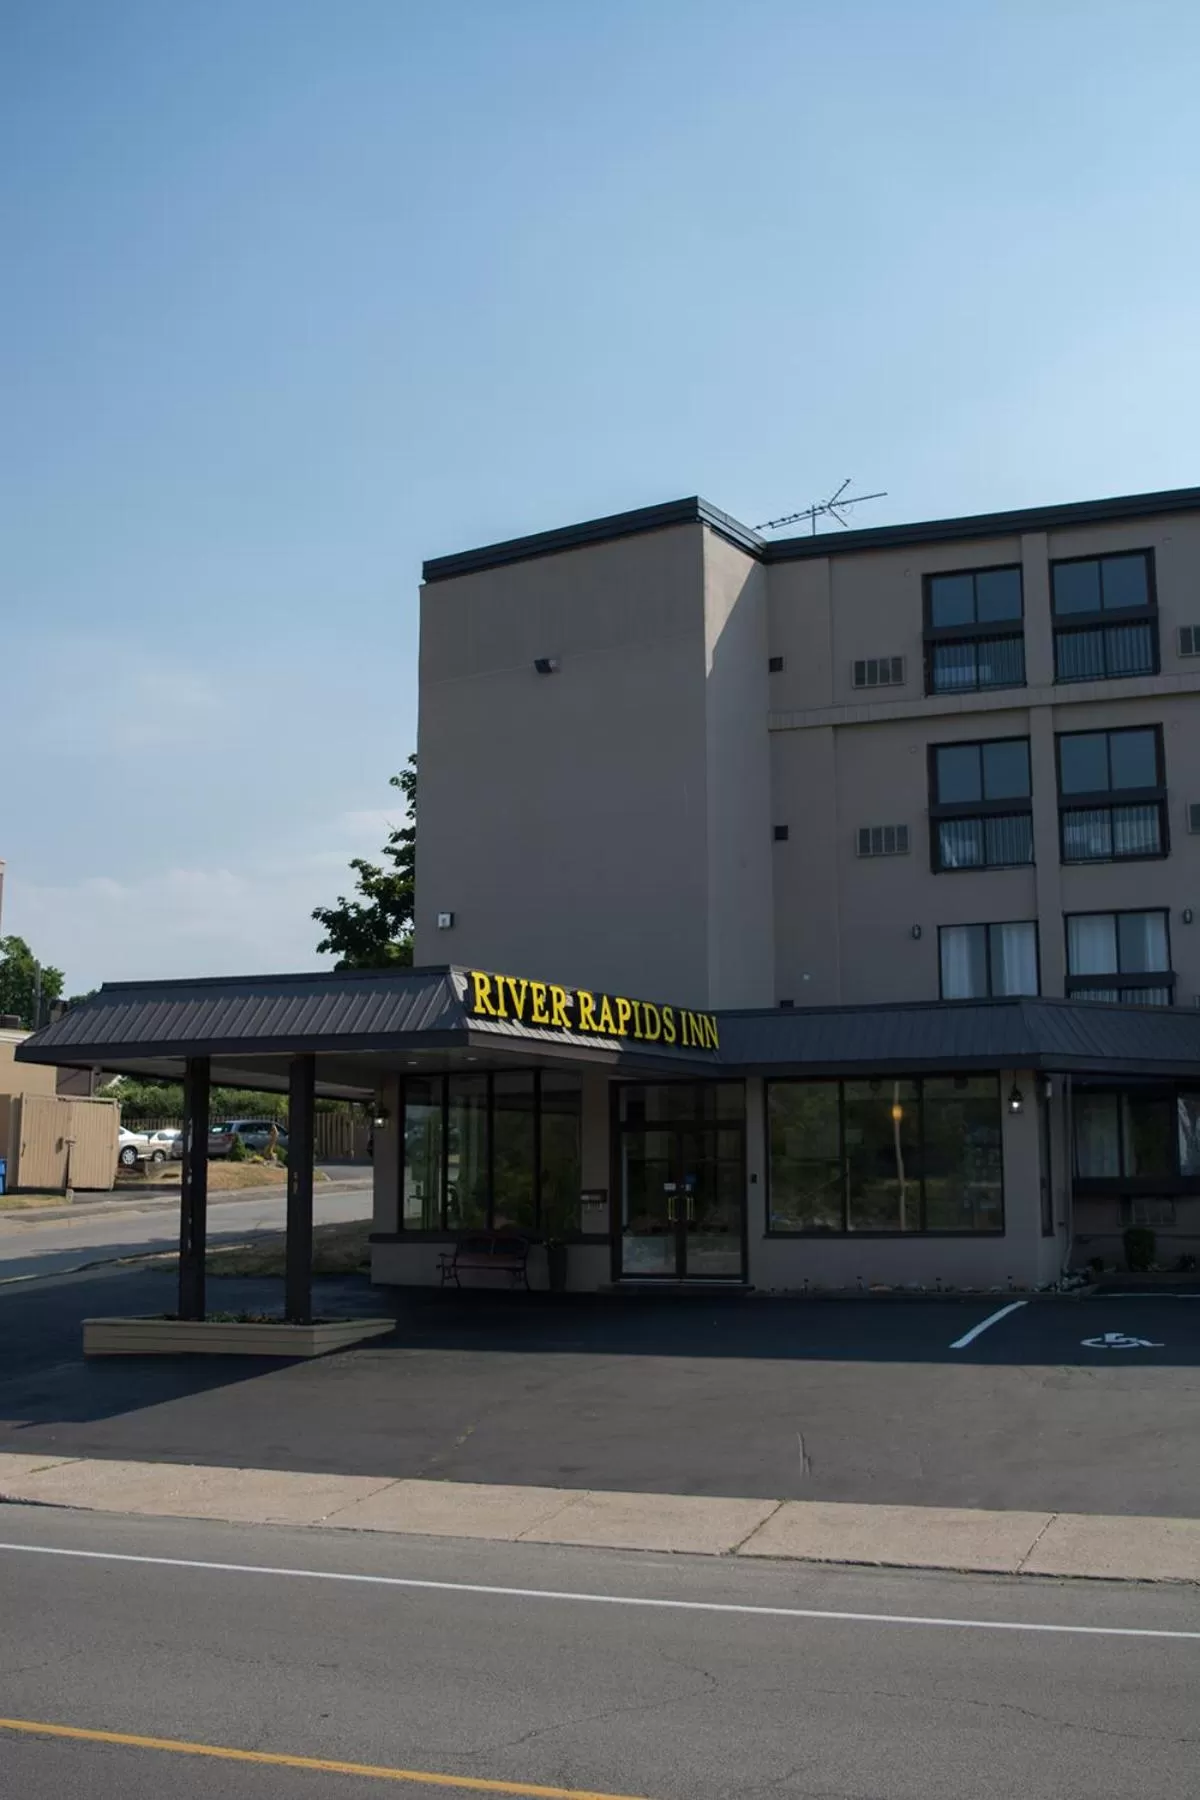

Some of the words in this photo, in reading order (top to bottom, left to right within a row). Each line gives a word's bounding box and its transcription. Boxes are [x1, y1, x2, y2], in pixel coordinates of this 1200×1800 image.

[471, 971, 571, 1028] RIVER
[577, 990, 676, 1042] RAPIDS
[680, 1010, 720, 1048] INN
